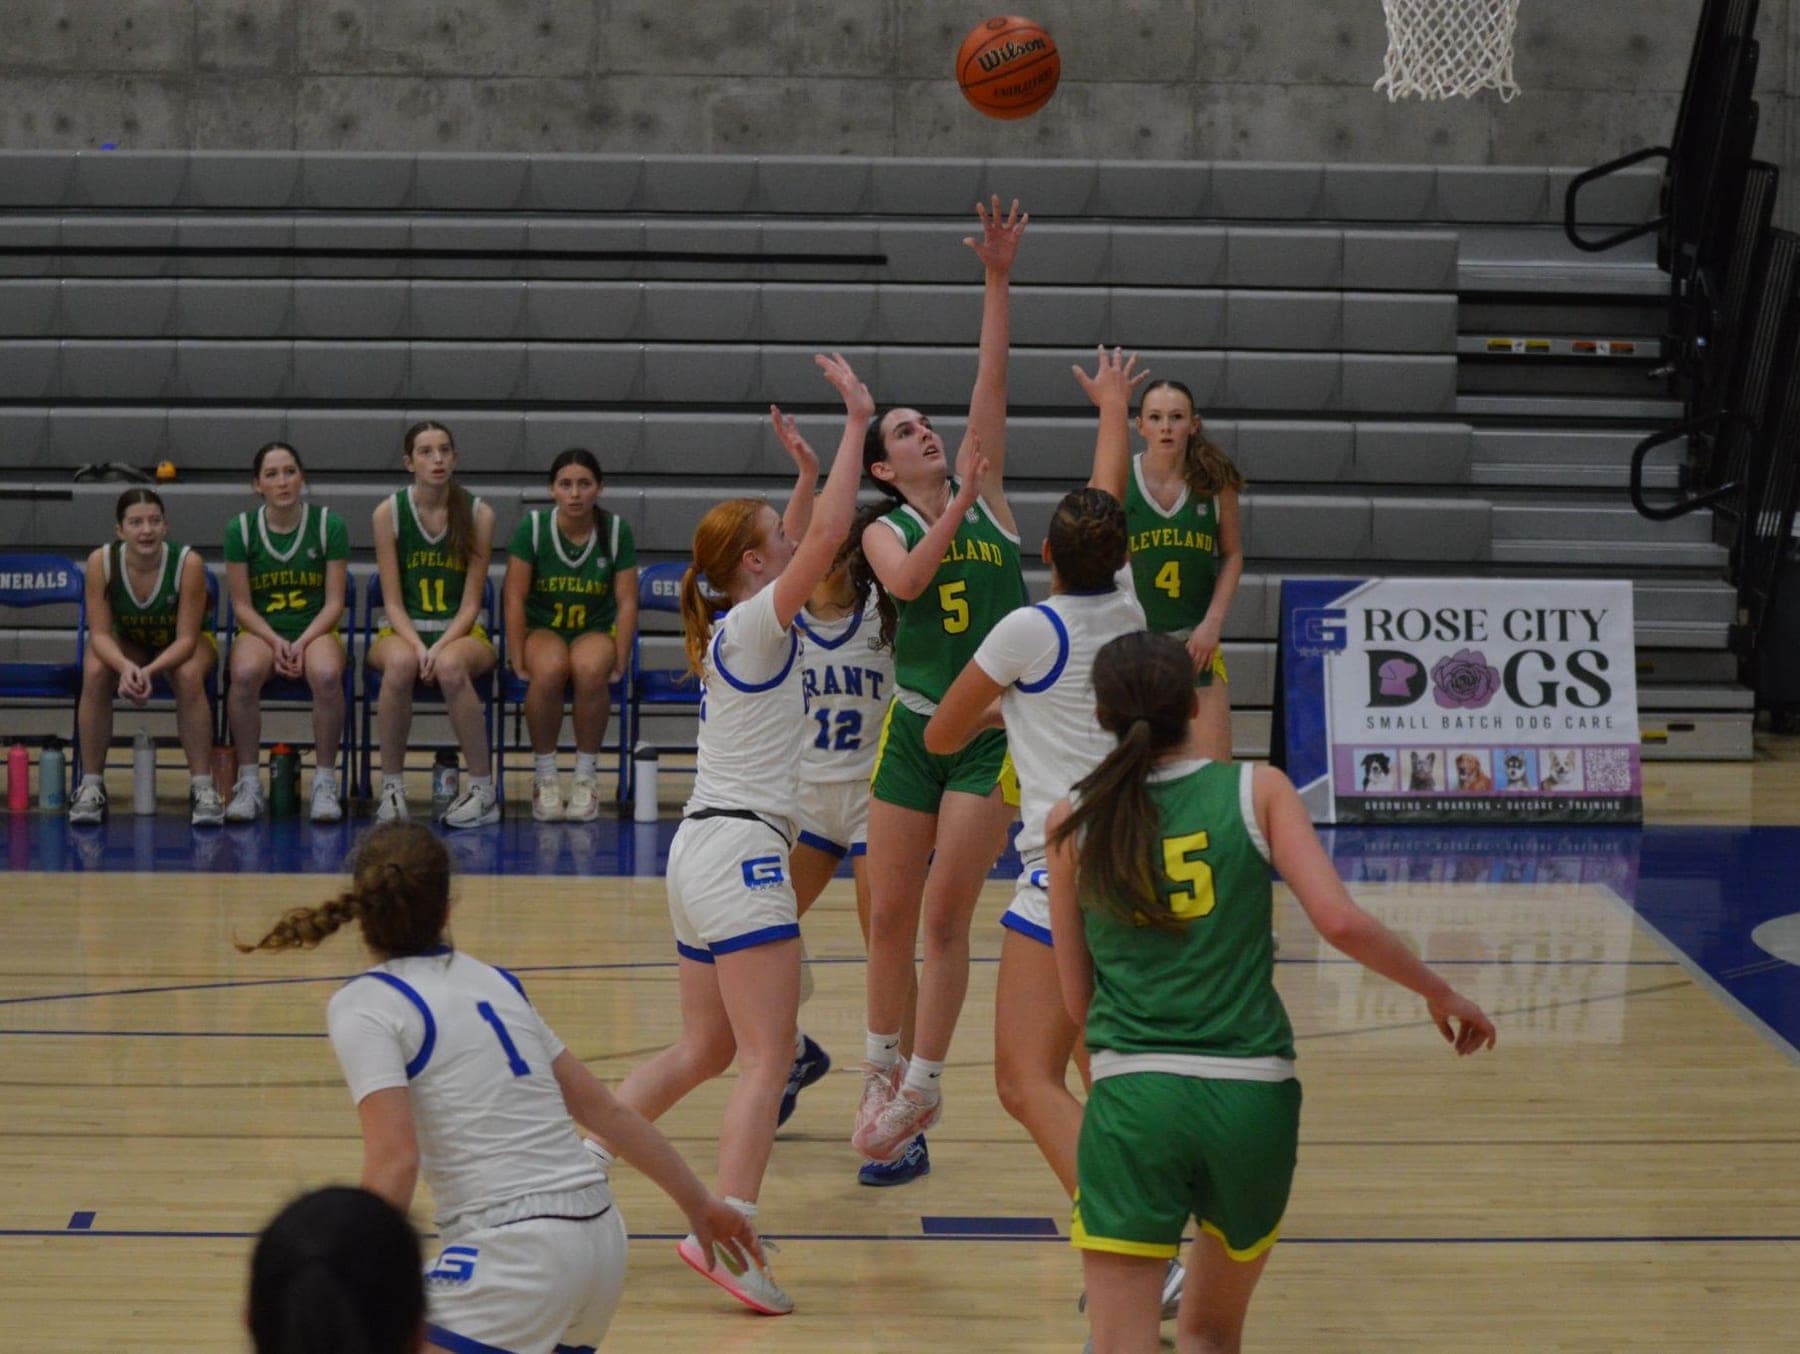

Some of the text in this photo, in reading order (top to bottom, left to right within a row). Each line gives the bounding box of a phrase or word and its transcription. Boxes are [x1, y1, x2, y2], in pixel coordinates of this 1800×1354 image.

[978, 38, 1047, 73] Wilson
[941, 538, 1003, 567] LAND
[1129, 528, 1213, 553] LEVELAND
[0, 572, 68, 590] NERALS
[418, 578, 449, 612] 11
[1154, 560, 1182, 599] 4
[937, 579, 970, 635] 5
[1363, 608, 1609, 642] ROSE CITY
[801, 665, 884, 701] RANT
[814, 708, 862, 751] 12
[1366, 716, 1613, 730] SMALL BATCH DOG CARE
[1568, 801, 1620, 811] TRAINING
[1136, 830, 1217, 924] 5
[475, 1001, 532, 1077] 1
